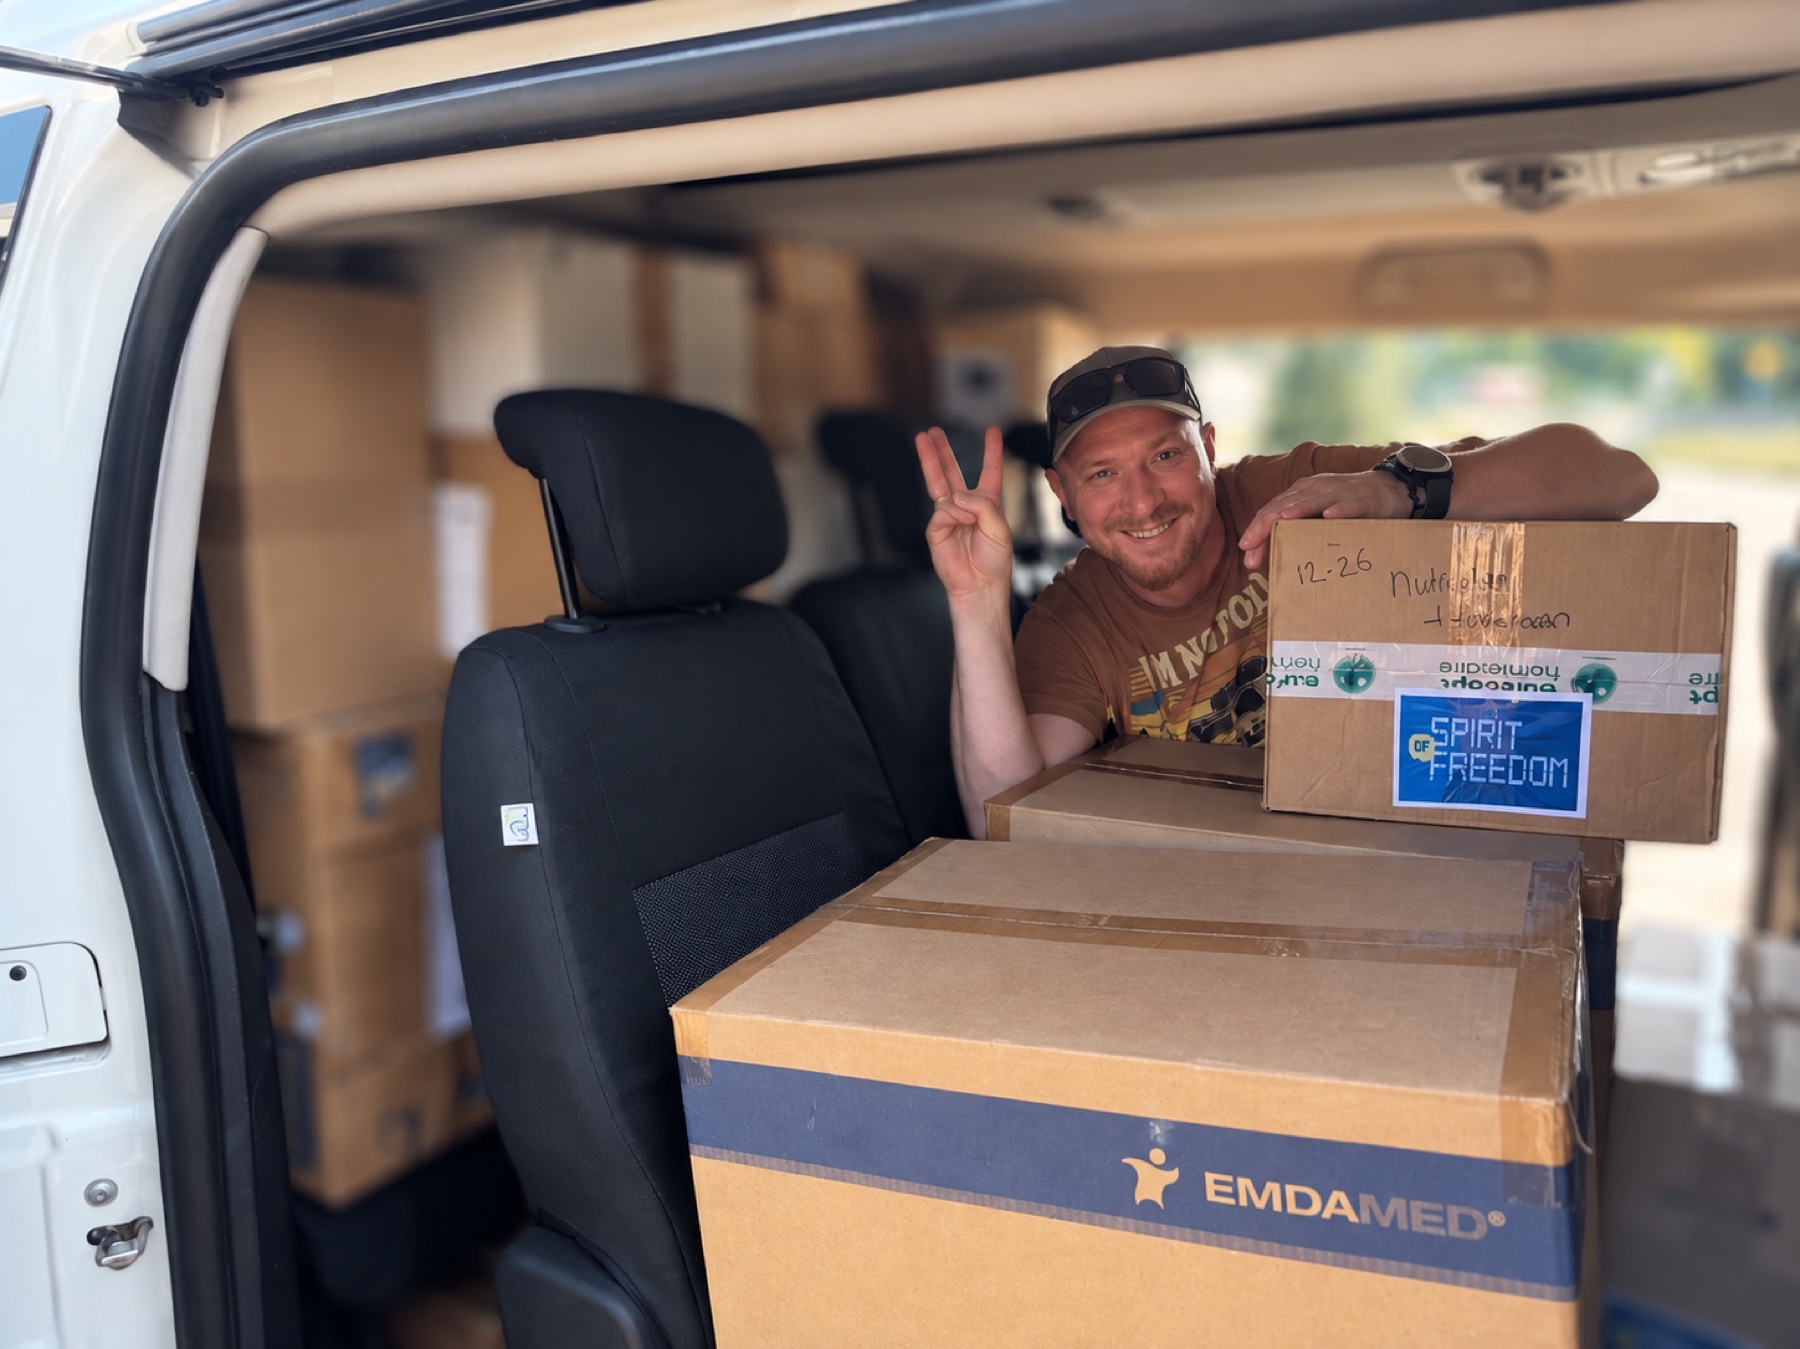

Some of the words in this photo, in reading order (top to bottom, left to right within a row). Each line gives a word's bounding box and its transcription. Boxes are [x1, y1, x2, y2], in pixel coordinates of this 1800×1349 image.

[1414, 739, 1431, 753] OF
[1430, 716, 1523, 750] SPIRIT
[1429, 751, 1569, 789] FREEDOM
